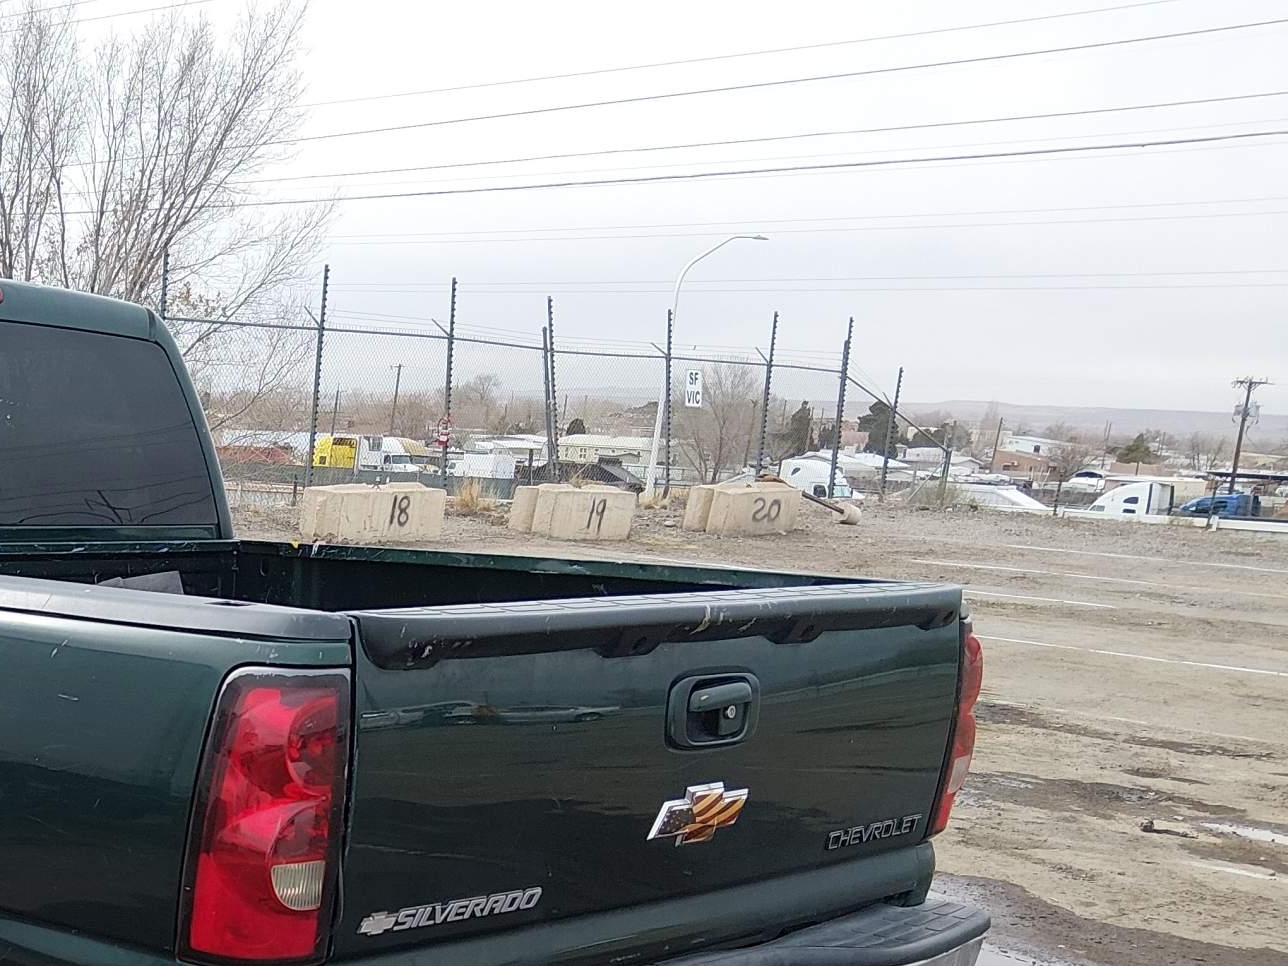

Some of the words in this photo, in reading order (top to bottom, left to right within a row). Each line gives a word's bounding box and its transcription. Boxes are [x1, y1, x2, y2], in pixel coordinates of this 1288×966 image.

[688, 371, 699, 386] SF
[686, 390, 701, 405] VIC
[388, 494, 411, 528] 18
[586, 496, 608, 537] 19
[751, 496, 782, 522] 20
[827, 813, 923, 850] CHEVROLET
[392, 886, 543, 931] SILVERADO
